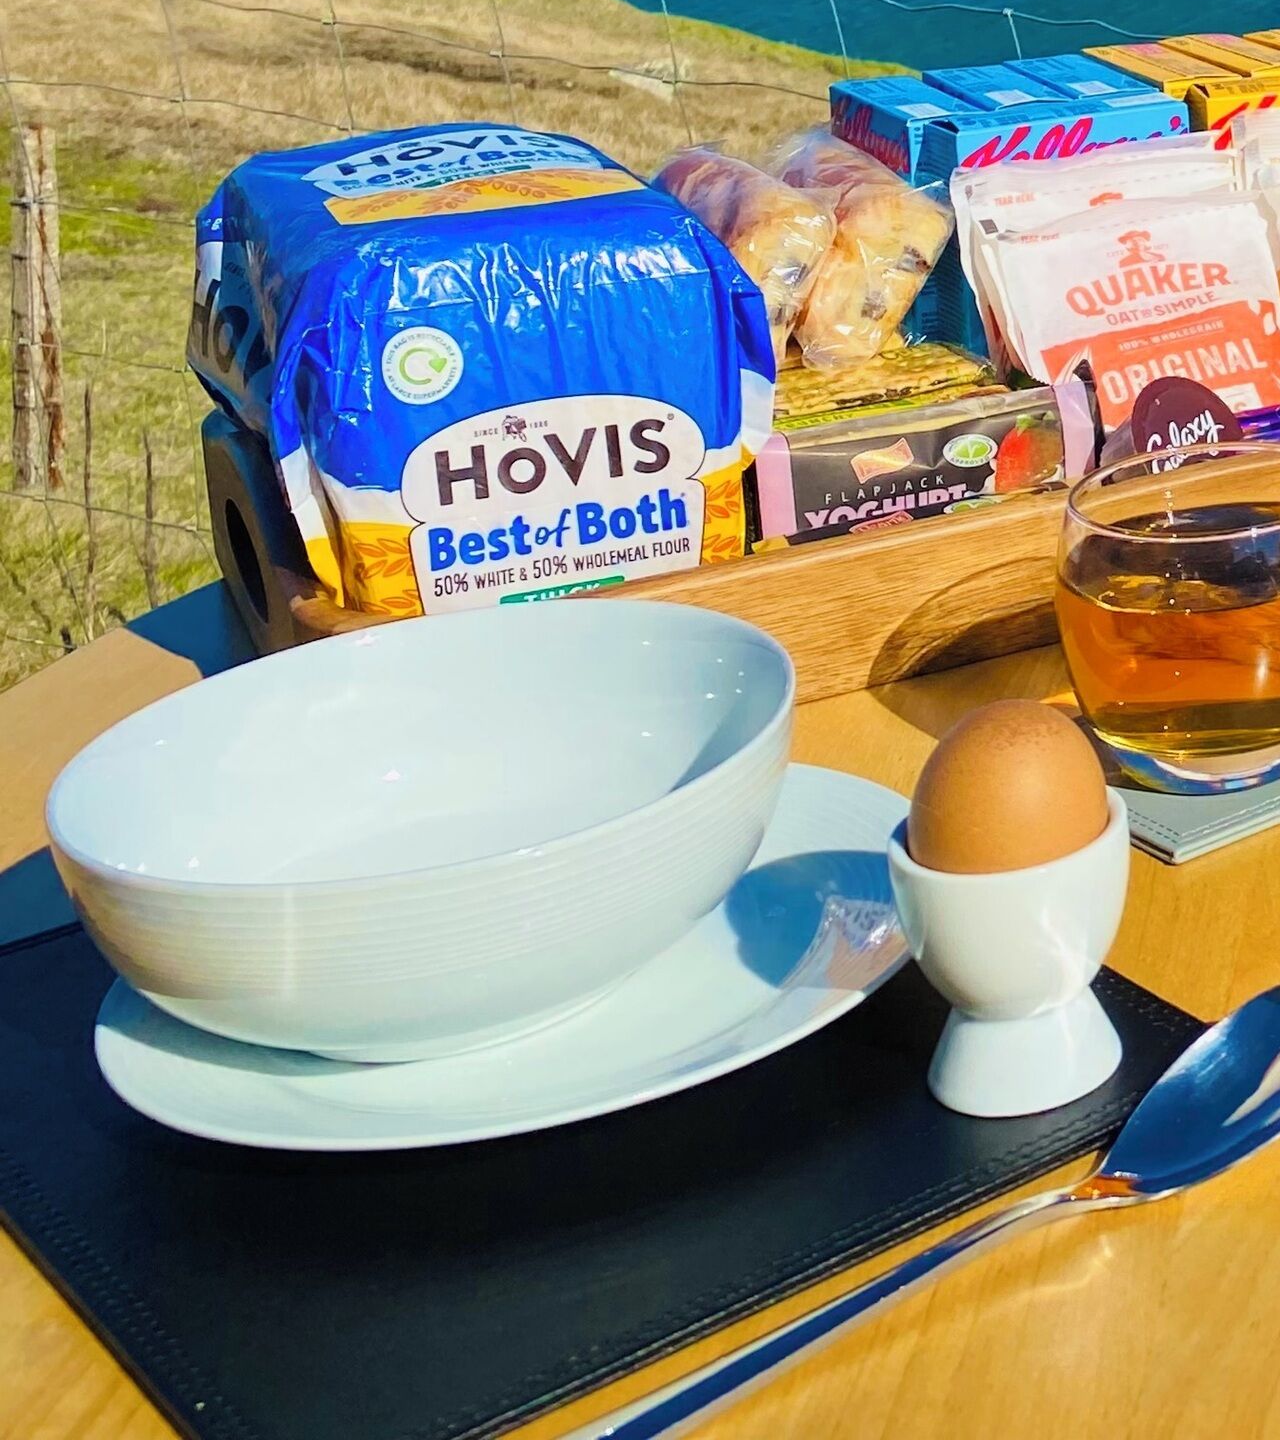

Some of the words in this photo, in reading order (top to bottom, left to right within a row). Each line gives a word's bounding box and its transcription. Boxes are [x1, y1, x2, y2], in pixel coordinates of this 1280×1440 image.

[1066, 262, 1231, 317] QUAKER
[1106, 309, 1142, 326] OAT
[1154, 290, 1221, 317] SIMPLE
[1150, 320, 1225, 344] WHOLEGRAIN
[1101, 337, 1268, 405] ORIGINAL
[434, 417, 671, 506] HOVIS
[1146, 409, 1225, 459] Galaxy
[824, 473, 945, 505] FLAPJACK
[428, 515, 532, 572] Best
[534, 508, 572, 548] of
[575, 488, 687, 546] Both
[433, 572, 469, 598] 50%
[474, 566, 515, 591] WHITE
[519, 565, 528, 582] &
[532, 554, 569, 580] 50%
[572, 544, 649, 572] WHOLEMEAL
[652, 537, 691, 561] FLOUR
